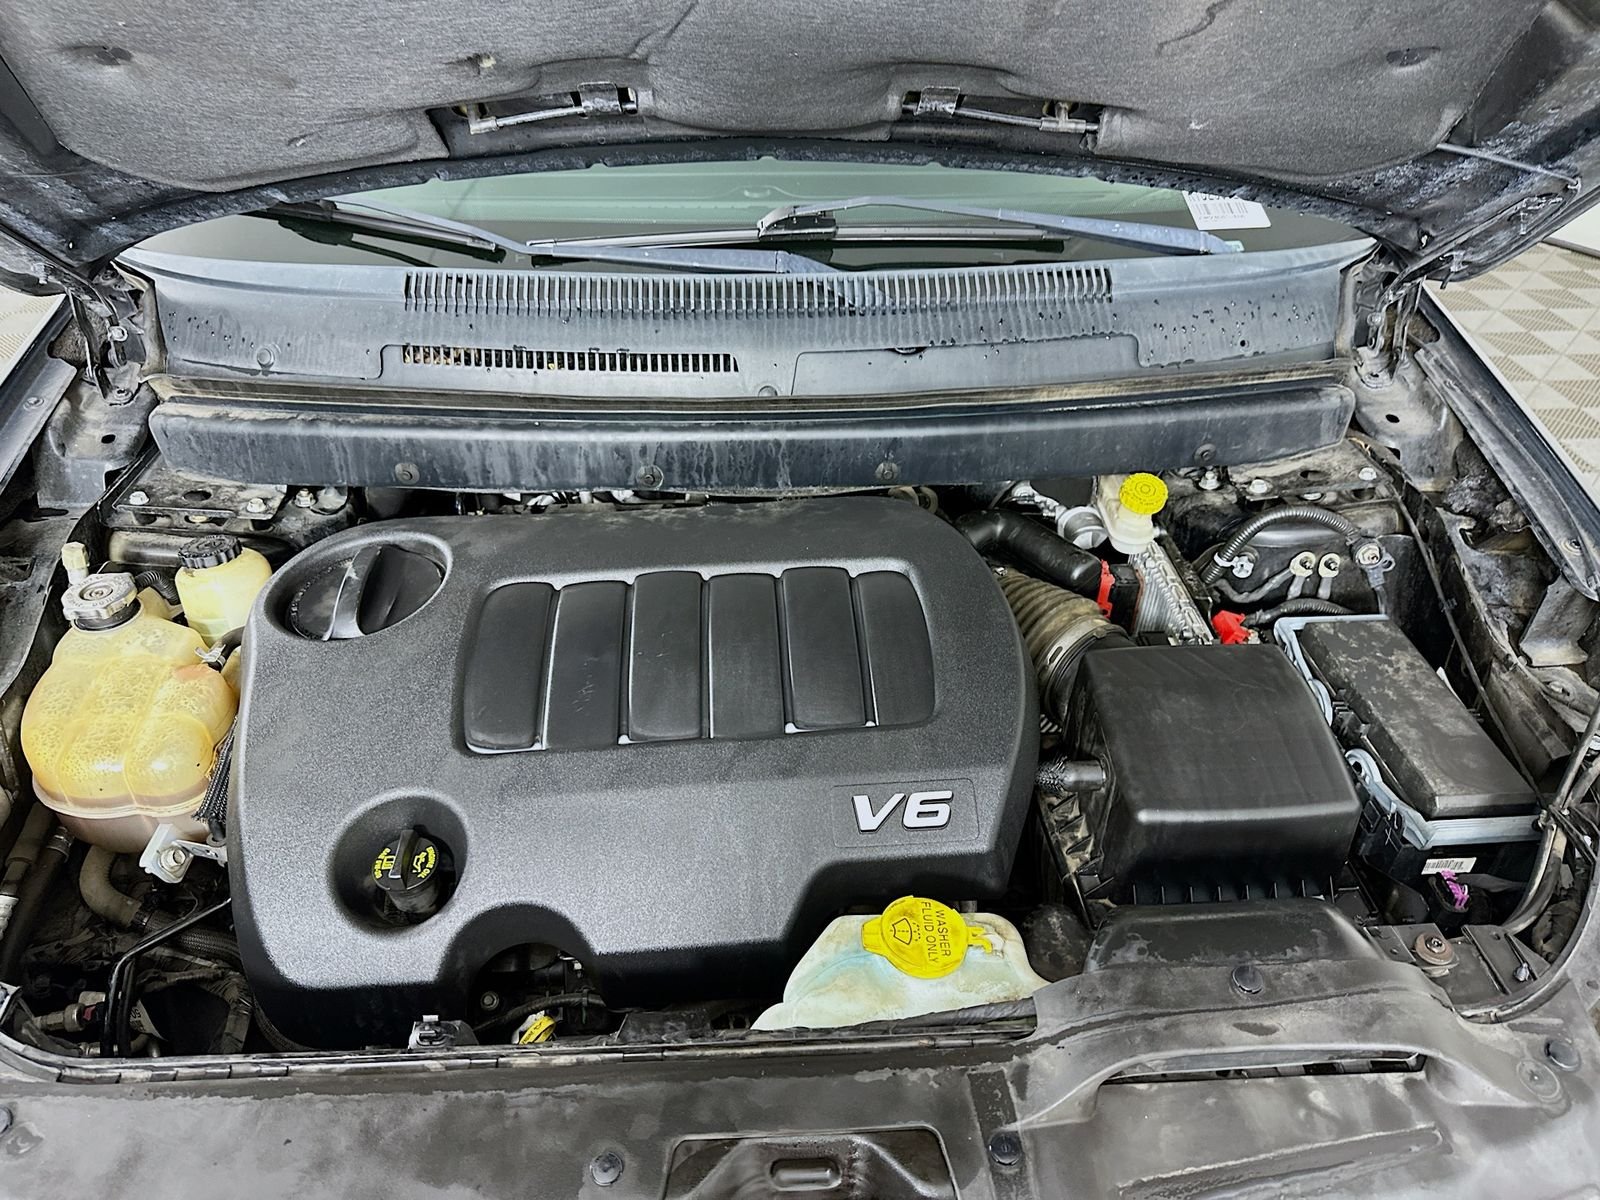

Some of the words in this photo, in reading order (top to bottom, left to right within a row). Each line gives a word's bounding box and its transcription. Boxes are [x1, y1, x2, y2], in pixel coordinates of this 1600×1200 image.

[852, 790, 954, 833] V6
[417, 868, 431, 879] OIL
[921, 901, 934, 933] FLUID
[935, 909, 952, 957] WASHER
[926, 935, 940, 963] ONLY
